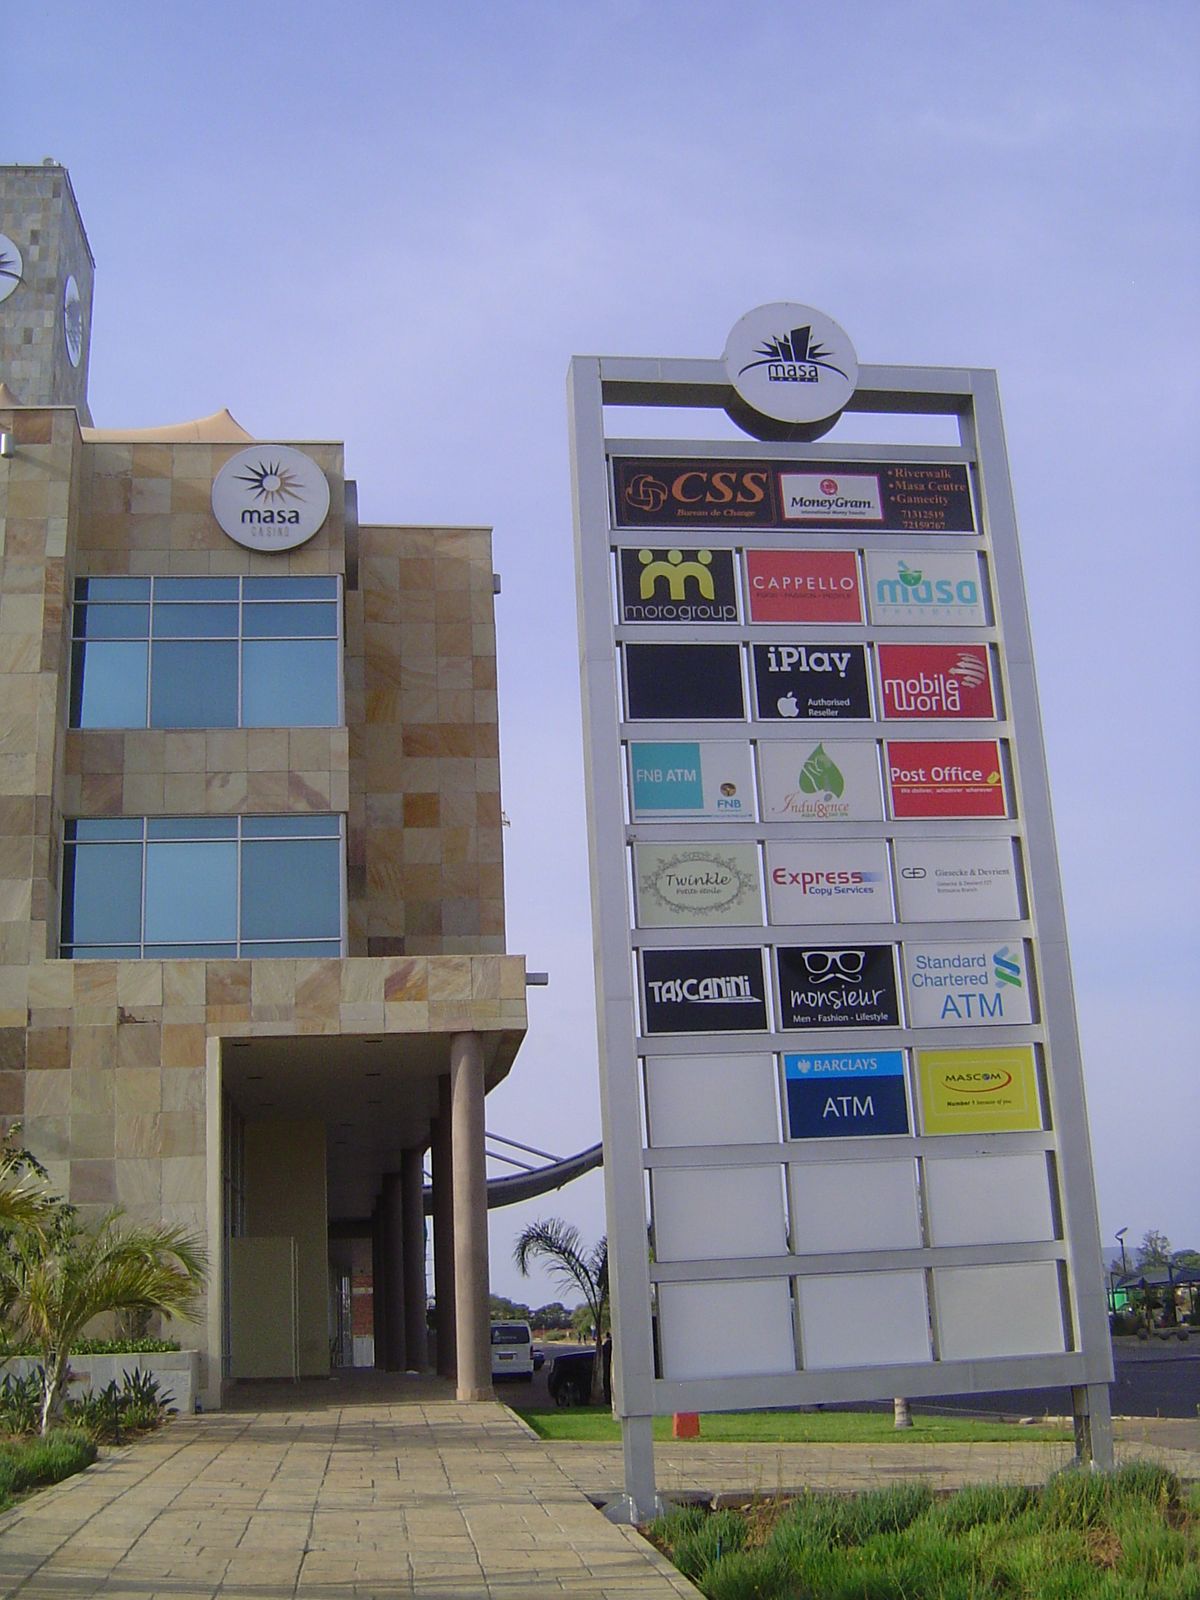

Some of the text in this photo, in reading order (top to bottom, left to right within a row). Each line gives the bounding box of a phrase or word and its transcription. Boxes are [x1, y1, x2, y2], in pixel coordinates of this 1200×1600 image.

[768, 363, 818, 377] masa
[894, 467, 951, 479] Riverwalk
[671, 471, 767, 503] CSS
[895, 480, 967, 492] Masa Centre
[791, 497, 872, 510] MoneyGram
[896, 493, 949, 506] Gamecity
[241, 509, 300, 524] masa
[710, 508, 722, 517] de
[723, 508, 756, 518] Change
[251, 526, 290, 537] CASINO
[753, 576, 854, 590] CAPPELLO
[876, 579, 978, 604] masa
[767, 646, 851, 678] iPlay
[884, 672, 959, 695] mobile
[807, 698, 851, 706] Authorised
[893, 693, 961, 711] world
[808, 708, 839, 717] Reseller
[636, 769, 697, 782] FNB ATM
[890, 766, 983, 782] Post Office
[716, 799, 742, 809] FNB
[775, 792, 850, 818] Indulgence
[666, 872, 731, 886] Twinkle
[772, 867, 864, 895] Express
[809, 885, 874, 896] Copy Services
[916, 953, 986, 969] Standard
[911, 971, 989, 988] Chartered
[790, 984, 884, 1009] monsieur
[940, 992, 1004, 1019] ATM
[793, 1014, 811, 1023] Men
[818, 1013, 849, 1022] Fashion
[855, 1012, 889, 1022] Lifestyle
[813, 1058, 878, 1072] BARCLAYS
[945, 1072, 1002, 1082] MASCOM
[822, 1095, 875, 1118] ATM
